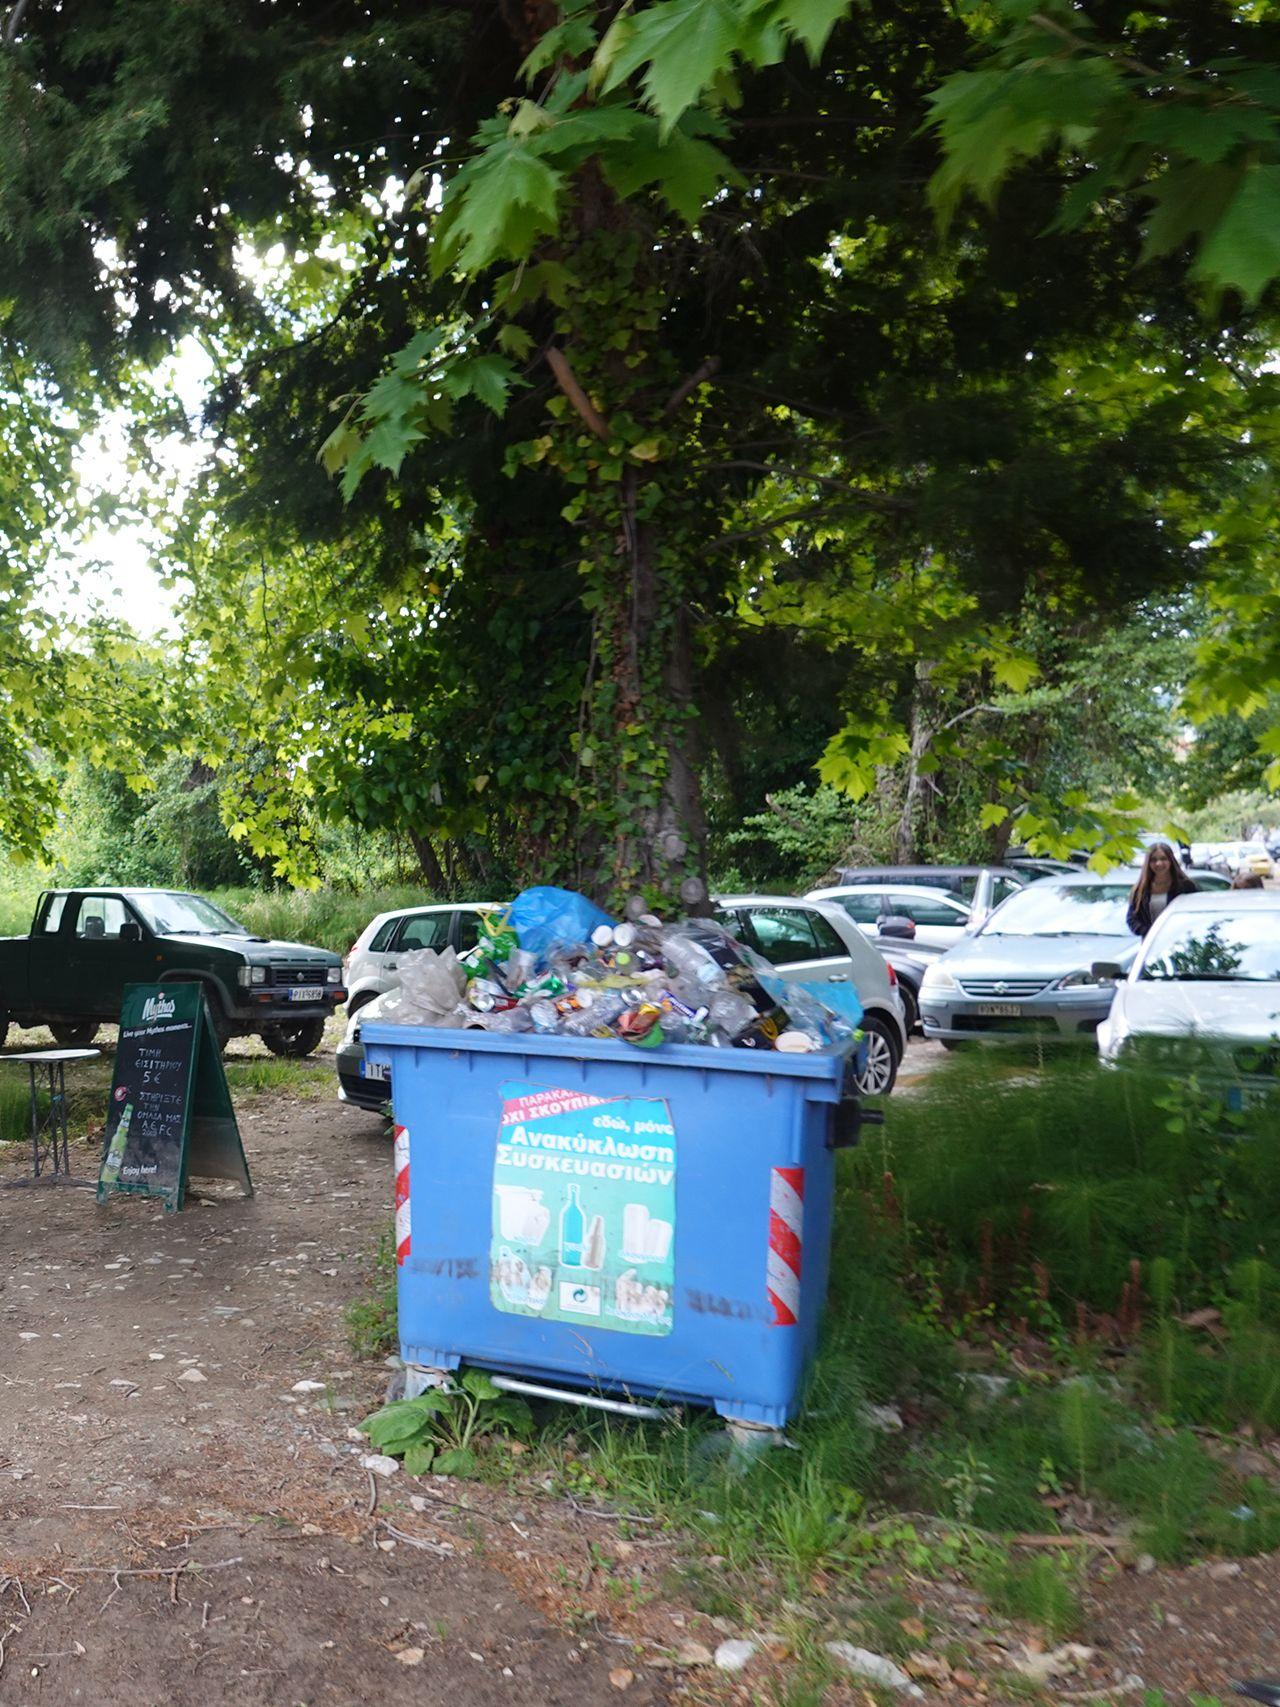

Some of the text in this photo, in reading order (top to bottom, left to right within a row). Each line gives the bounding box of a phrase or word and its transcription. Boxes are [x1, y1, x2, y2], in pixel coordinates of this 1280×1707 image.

[142, 997, 176, 1021] Mythos
[146, 1026, 165, 1035] Mythos
[138, 1048, 161, 1057] ΤΙΜΗ
[510, 1126, 674, 1163] Ανακύκλωση
[123, 1165, 141, 1176] Enjoy
[496, 1143, 674, 1185] Συσκευασιών
